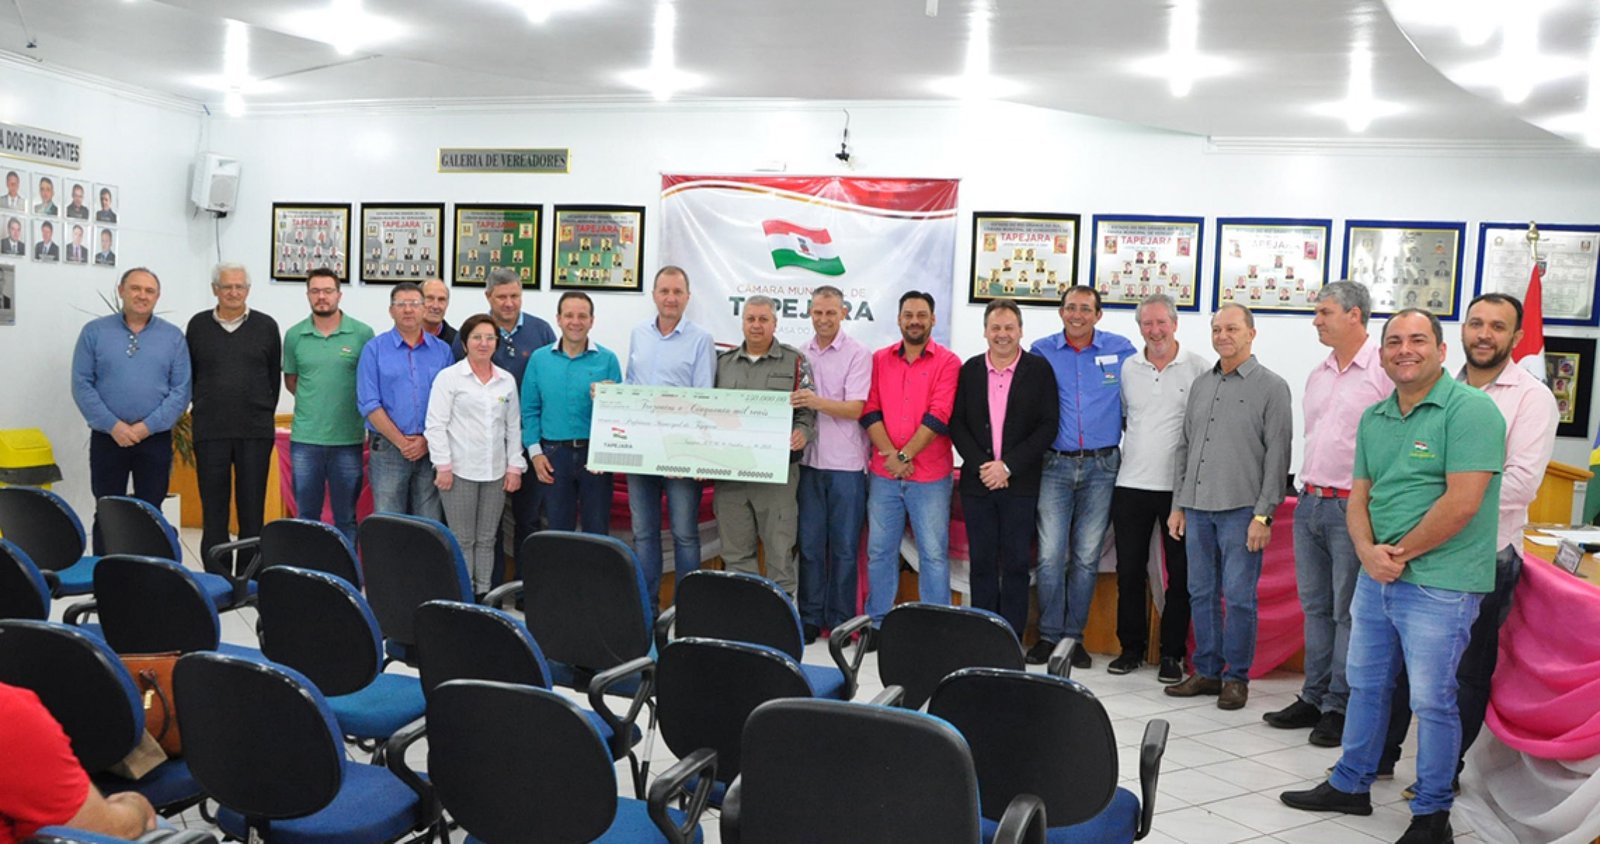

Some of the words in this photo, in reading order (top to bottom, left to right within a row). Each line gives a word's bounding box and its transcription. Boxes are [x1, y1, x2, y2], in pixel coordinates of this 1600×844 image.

[6, 130, 24, 152] DOS
[26, 134, 80, 162] PRESIDENTES
[441, 153, 483, 167] GALERIA
[485, 153, 498, 167] DE
[500, 153, 566, 167] VEREADORES
[383, 220, 420, 228] TAPEJARA
[576, 223, 618, 233] TAPEJARA
[1001, 232, 1051, 242] TAPEJARA
[851, 287, 866, 297] DE
[729, 295, 874, 322] TPEJRA
[733, 405, 749, 415] mil
